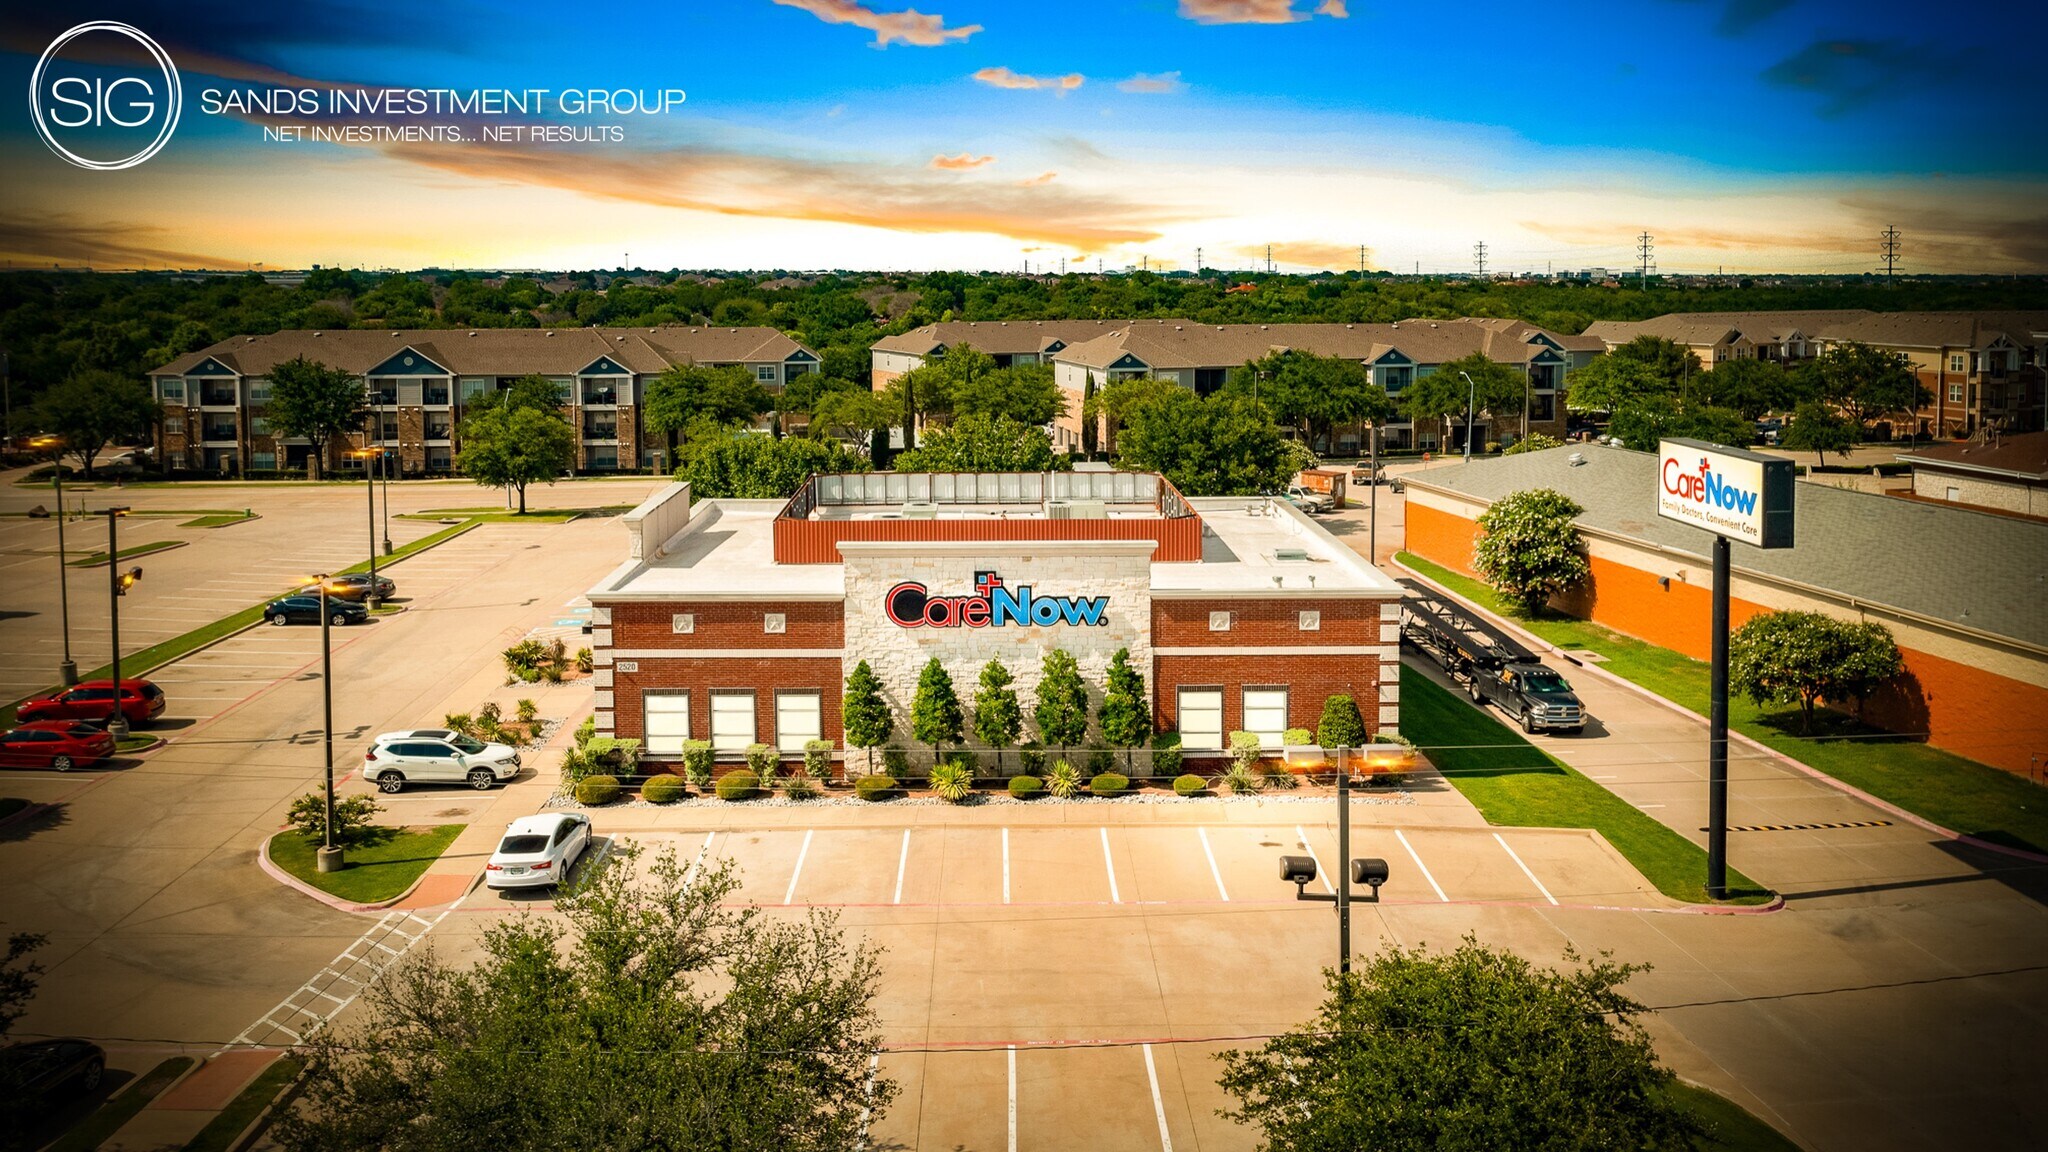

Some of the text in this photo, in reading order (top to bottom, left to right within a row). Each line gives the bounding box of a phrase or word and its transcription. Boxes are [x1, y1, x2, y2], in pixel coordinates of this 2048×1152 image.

[1663, 457, 1757, 516] CareNow
[1662, 499, 1758, 537] Family Doctors, Convenient Care
[618, 663, 636, 671] 2520
